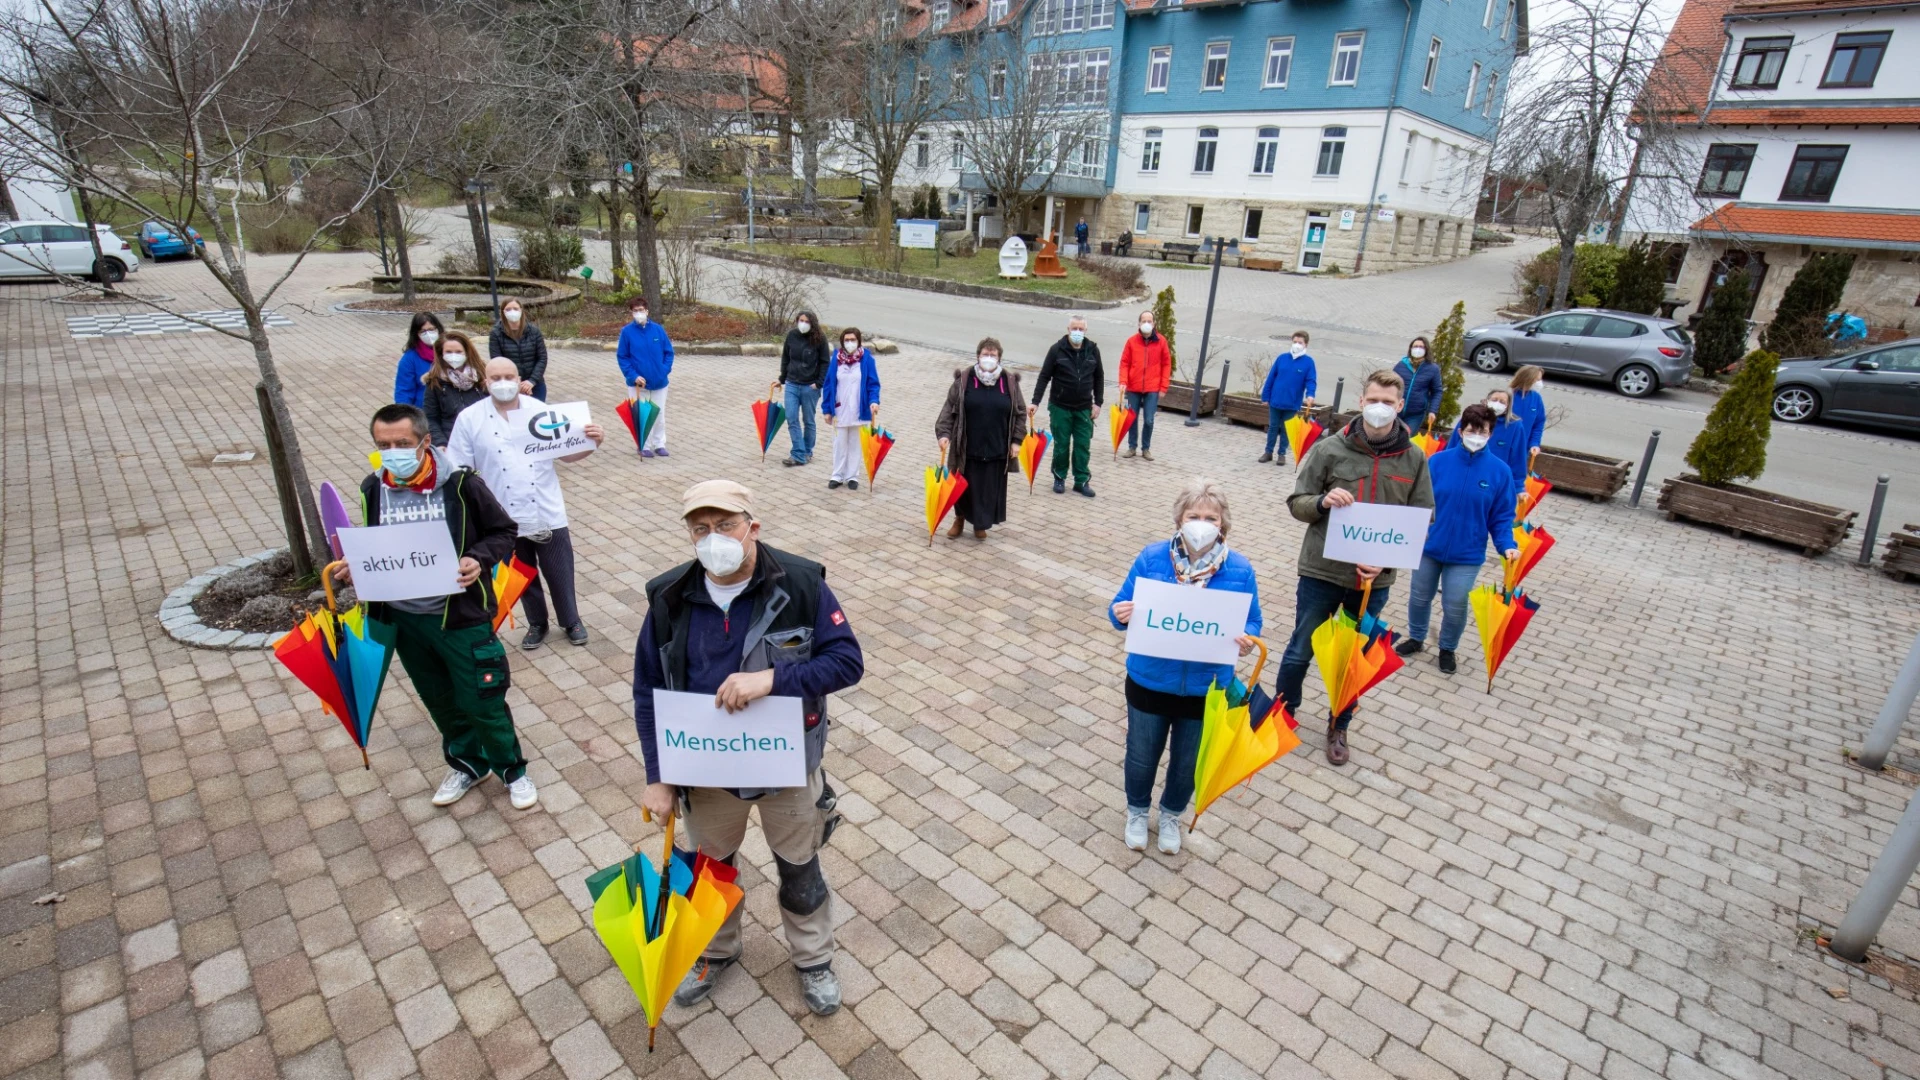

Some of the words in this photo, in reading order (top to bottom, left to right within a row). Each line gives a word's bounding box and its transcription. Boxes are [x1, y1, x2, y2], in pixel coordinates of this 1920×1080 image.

[524, 441, 562, 455] Erlacher
[563, 436, 586, 449] Höhe
[1342, 524, 1409, 545] Würde.
[362, 556, 405, 572] aktiv
[410, 552, 437, 568] für
[1146, 608, 1225, 636] Leben.
[665, 728, 795, 751] Menschen.
